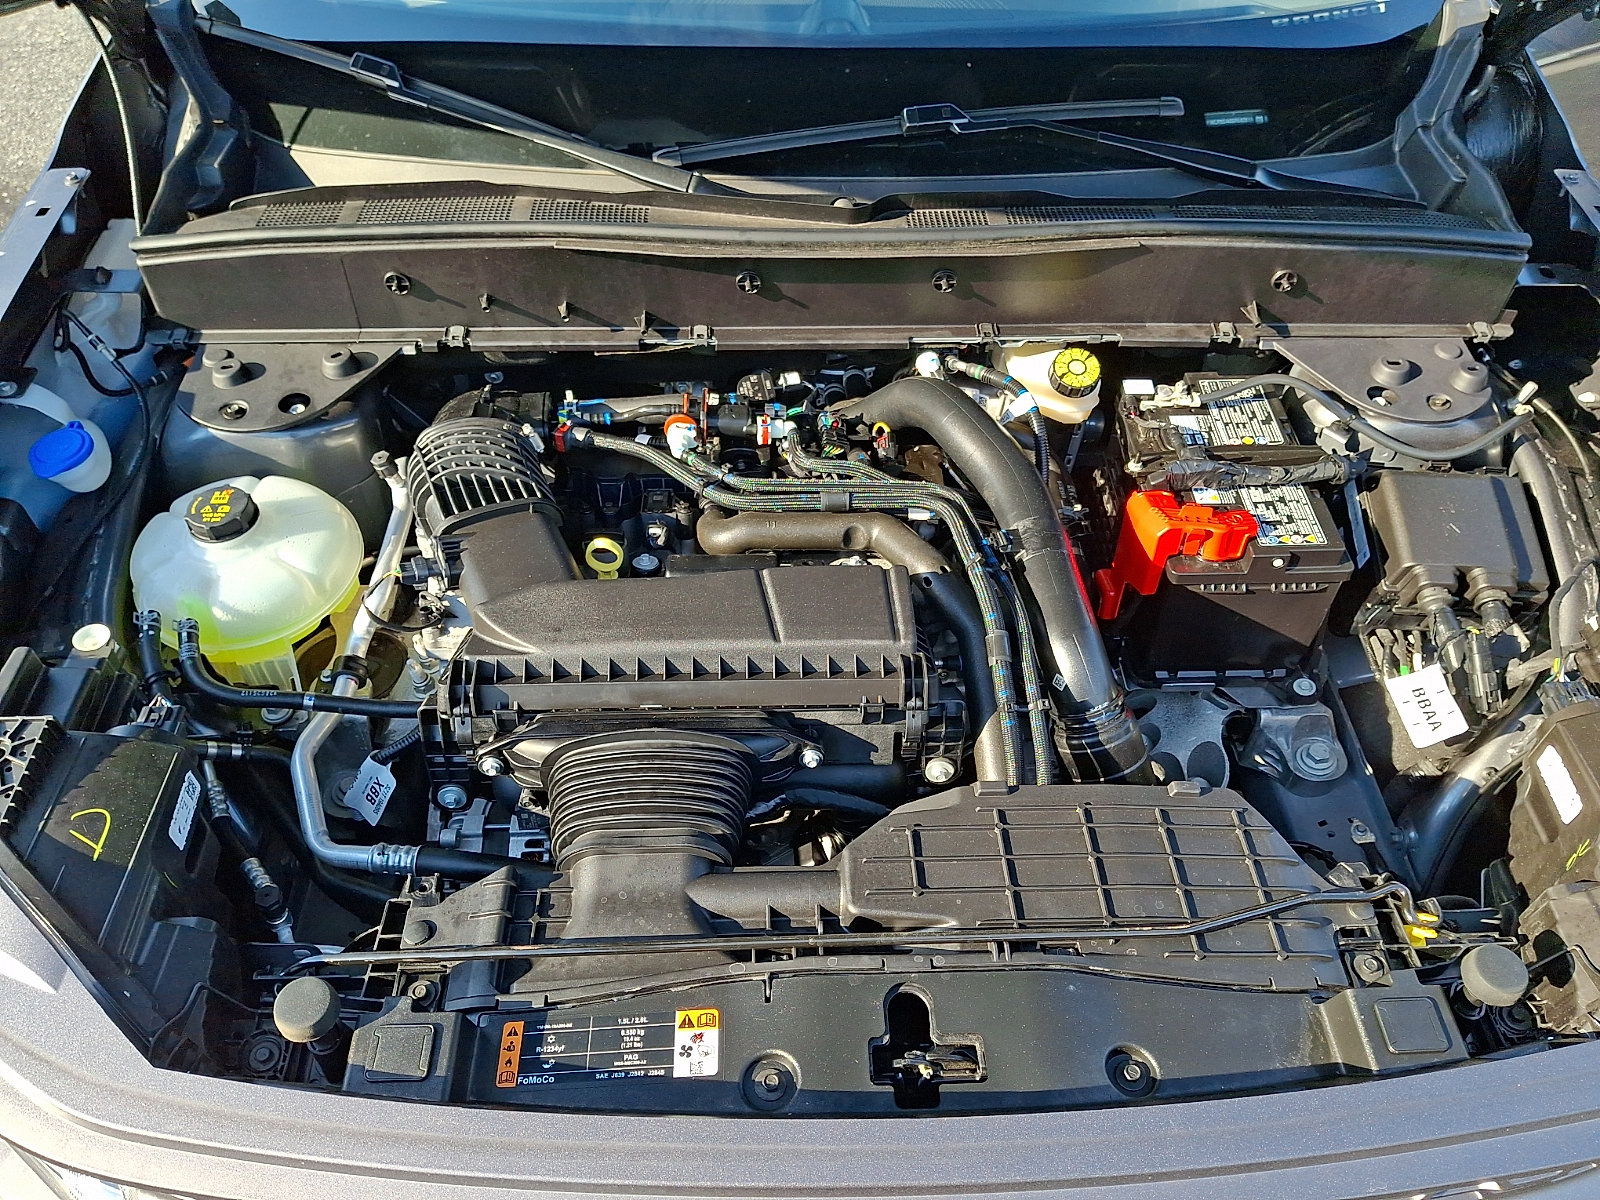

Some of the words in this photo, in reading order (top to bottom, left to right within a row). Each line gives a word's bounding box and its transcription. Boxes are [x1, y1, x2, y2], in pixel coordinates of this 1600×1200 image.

[1412, 687, 1442, 732] BBAA
[365, 776, 385, 806] XBB
[535, 1045, 566, 1054] R-1234yf
[623, 1053, 639, 1061] PAG
[517, 1075, 555, 1085] FoMoCo
[595, 1072, 609, 1080] SAE
